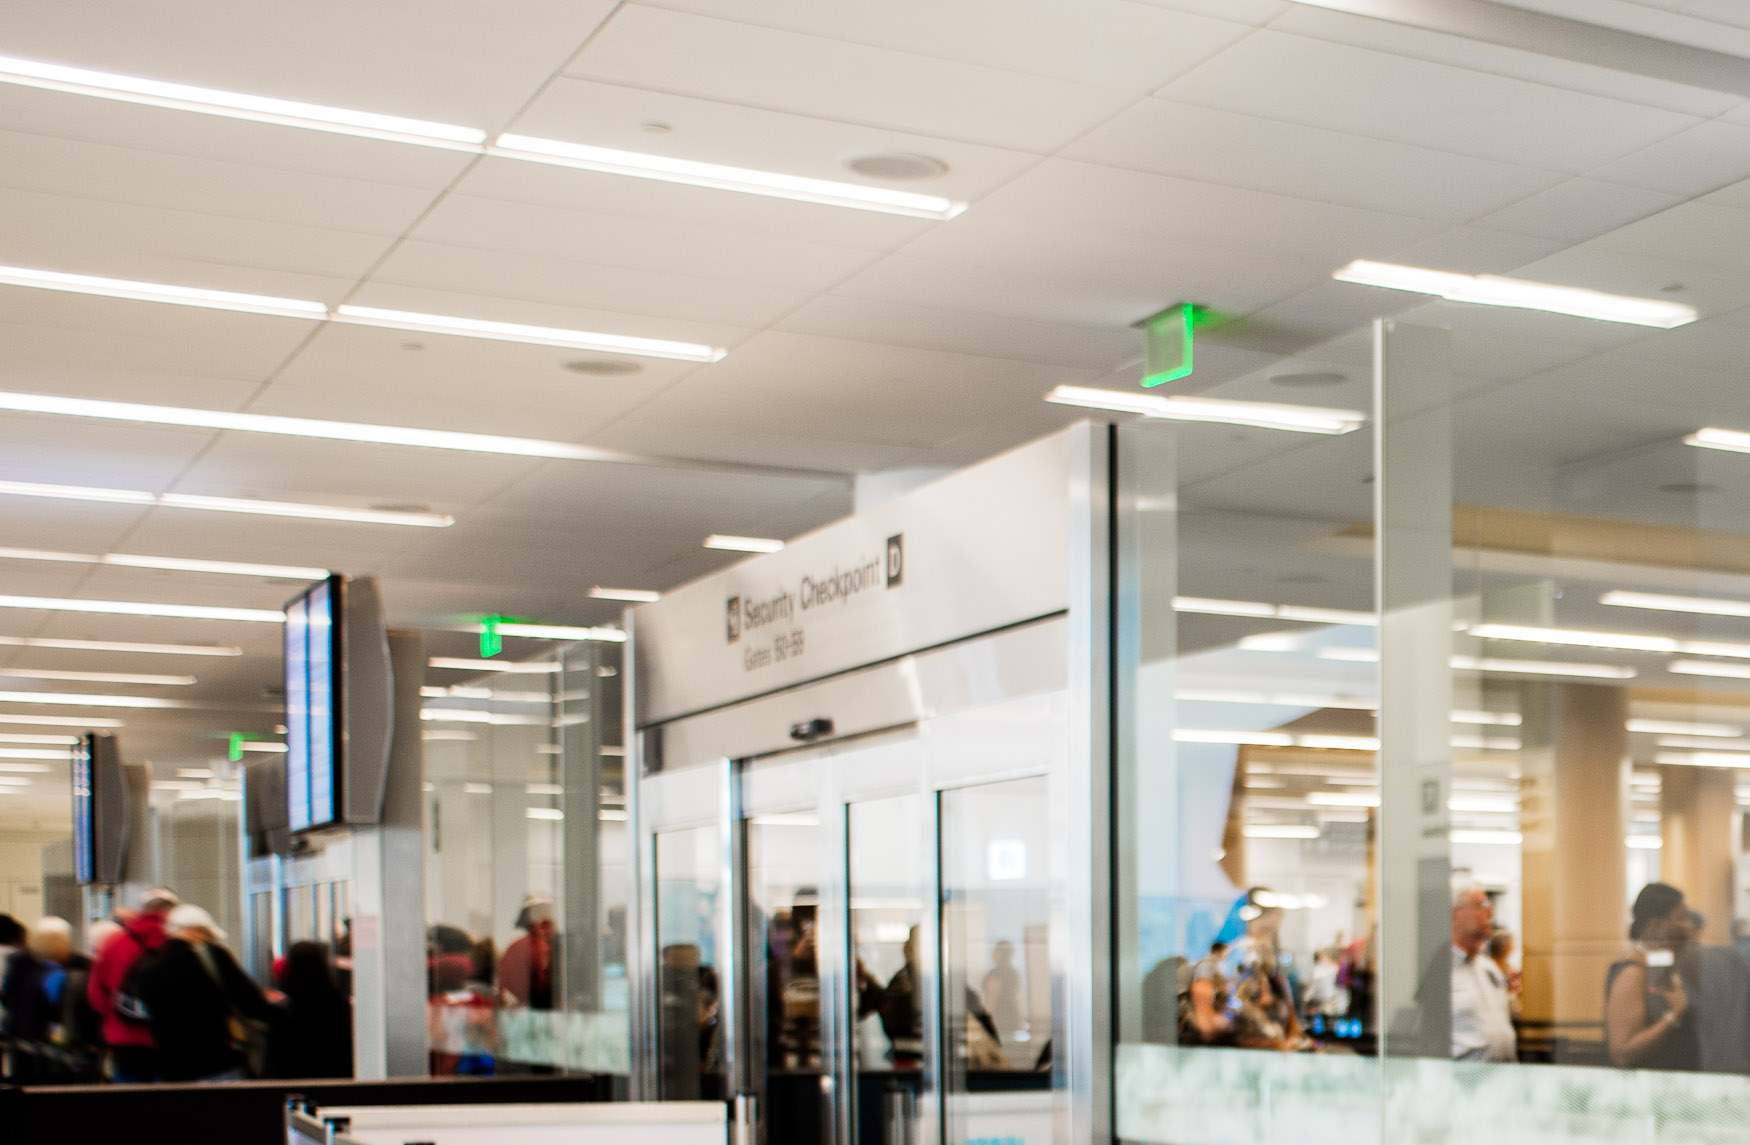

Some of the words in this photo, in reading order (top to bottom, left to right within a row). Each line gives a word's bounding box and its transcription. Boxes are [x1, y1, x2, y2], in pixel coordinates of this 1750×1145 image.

[744, 586, 796, 630] Security
[801, 556, 881, 610] Checkpoint
[889, 543, 903, 579] D
